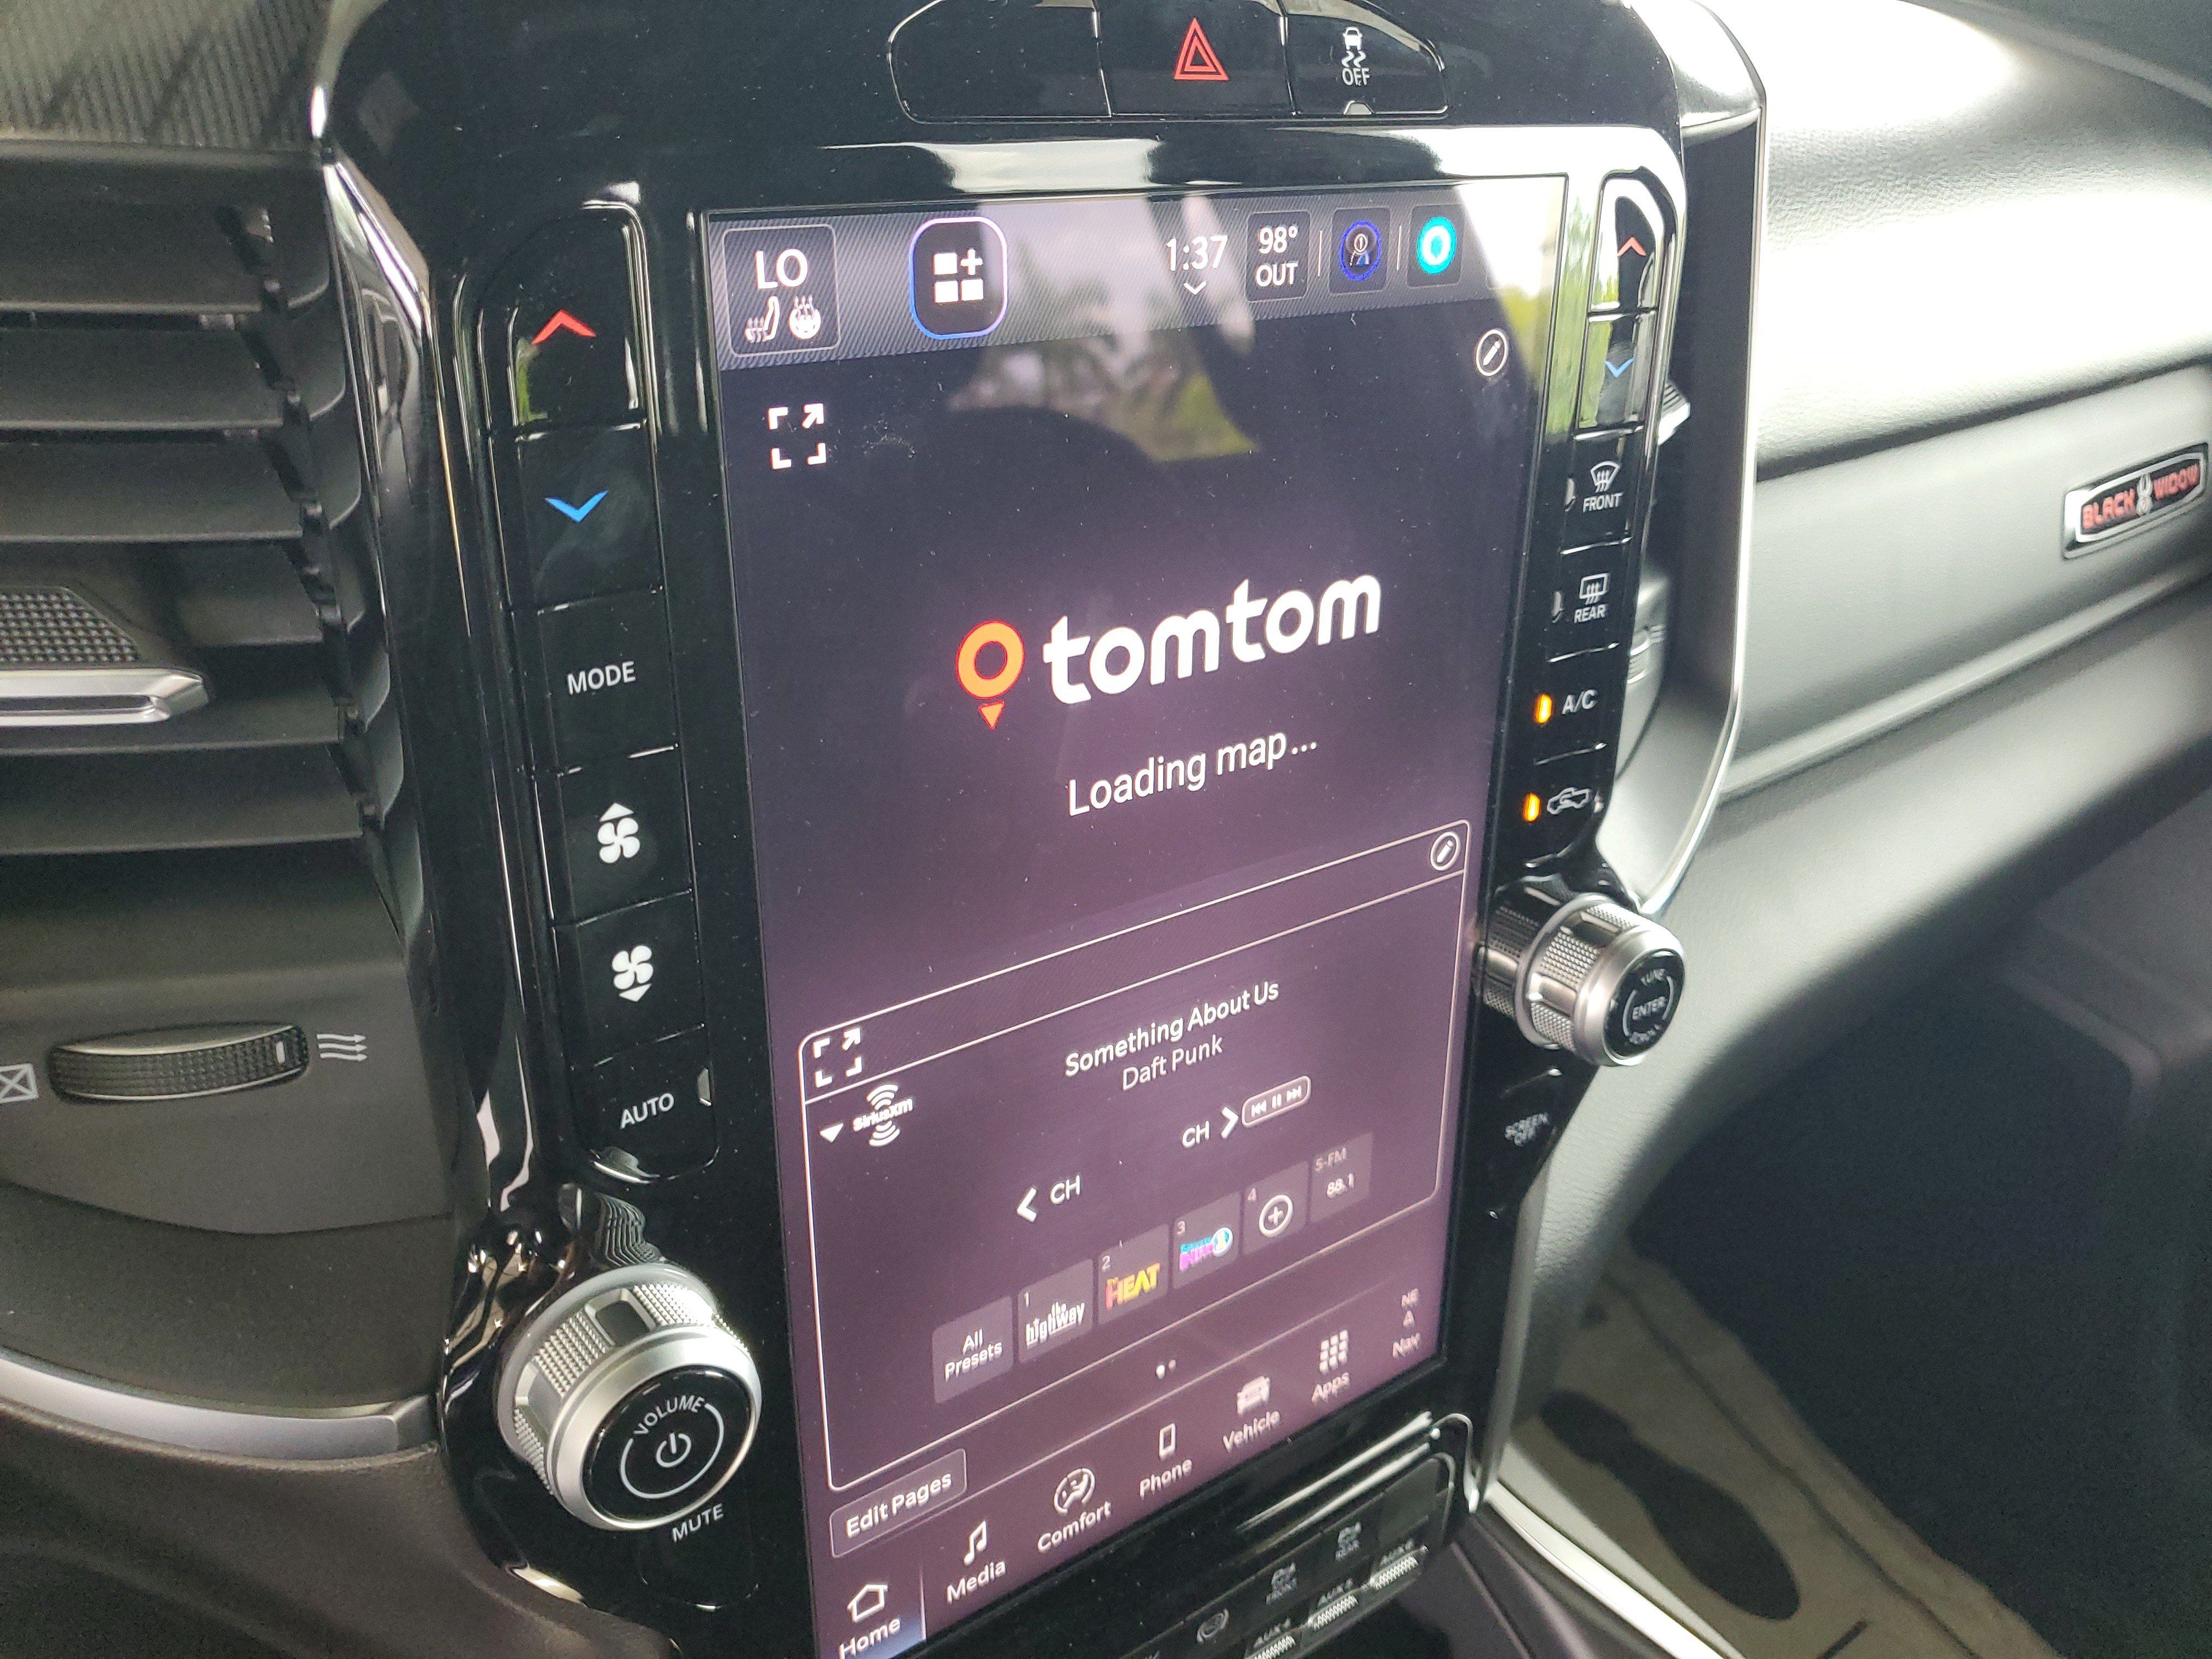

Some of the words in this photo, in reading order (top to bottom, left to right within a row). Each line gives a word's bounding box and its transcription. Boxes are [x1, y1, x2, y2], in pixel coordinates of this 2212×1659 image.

[1342, 67, 1370, 86] OFF
[755, 249, 809, 289] LO
[1166, 234, 1228, 272] 1:37
[1256, 262, 1299, 287] OUT
[1583, 493, 1624, 513] FRONT
[2082, 488, 2136, 529] BLACK
[1574, 604, 1607, 624] REAR
[1042, 574, 1381, 704] tomtom
[567, 661, 636, 695] MODE
[1562, 689, 1598, 714] A/C
[1068, 752, 1206, 816] Loading
[1632, 996, 1666, 1020] ENTER
[1065, 1018, 1184, 1077] Something
[1186, 990, 1250, 1031] About
[1254, 981, 1279, 1005] Us
[1122, 1054, 1167, 1091] Daft
[1171, 1034, 1223, 1071] Punk
[620, 1093, 675, 1129] AUTO
[1182, 1121, 1210, 1148] CH
[1050, 1175, 1081, 1205] CH
[1247, 1188, 1257, 1201] 4
[1327, 1173, 1355, 1198] 88.1
[1177, 1221, 1186, 1235] 3
[1102, 1255, 1110, 1272] 2
[1024, 1291, 1030, 1307] 1
[1105, 1263, 1160, 1310] HEAT
[962, 1329, 984, 1355] All
[1025, 1302, 1085, 1350] highway
[944, 1342, 1003, 1383] Presets
[1393, 1333, 1421, 1359] Nav
[1312, 1372, 1350, 1405] Apps
[634, 1395, 705, 1435] VOLUME
[1223, 1410, 1280, 1453] Vehicle
[1139, 1459, 1193, 1499] Phone
[672, 1503, 724, 1542] MUTE
[846, 1503, 889, 1537] Edit
[891, 1472, 952, 1516] Pages
[1037, 1501, 1111, 1553] Comfort
[947, 1560, 1007, 1604] Media
[839, 1617, 901, 1659] Home
